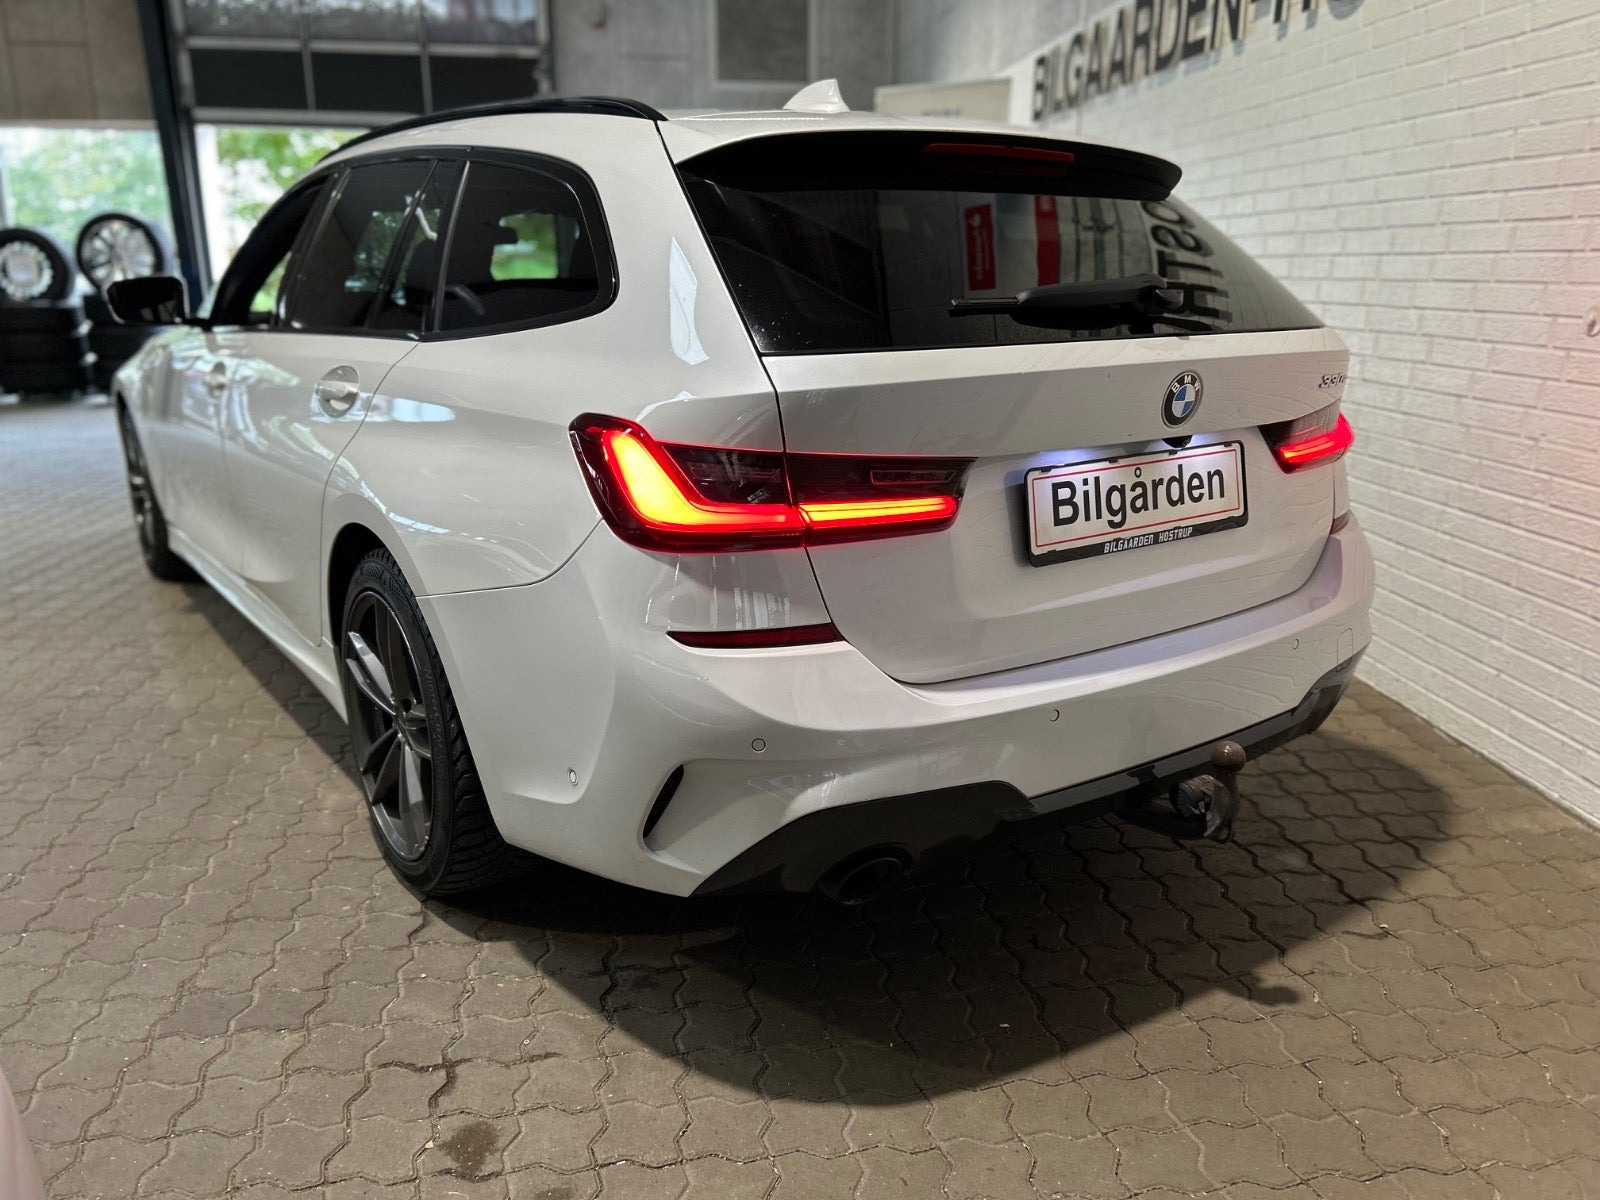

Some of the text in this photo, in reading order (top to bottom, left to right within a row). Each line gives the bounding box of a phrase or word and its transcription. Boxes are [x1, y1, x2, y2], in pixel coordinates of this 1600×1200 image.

[1171, 374, 1201, 393] BMW
[1051, 463, 1226, 530] Bilgården
[1103, 526, 1193, 554] BILGAARDEN HOSTRUP
